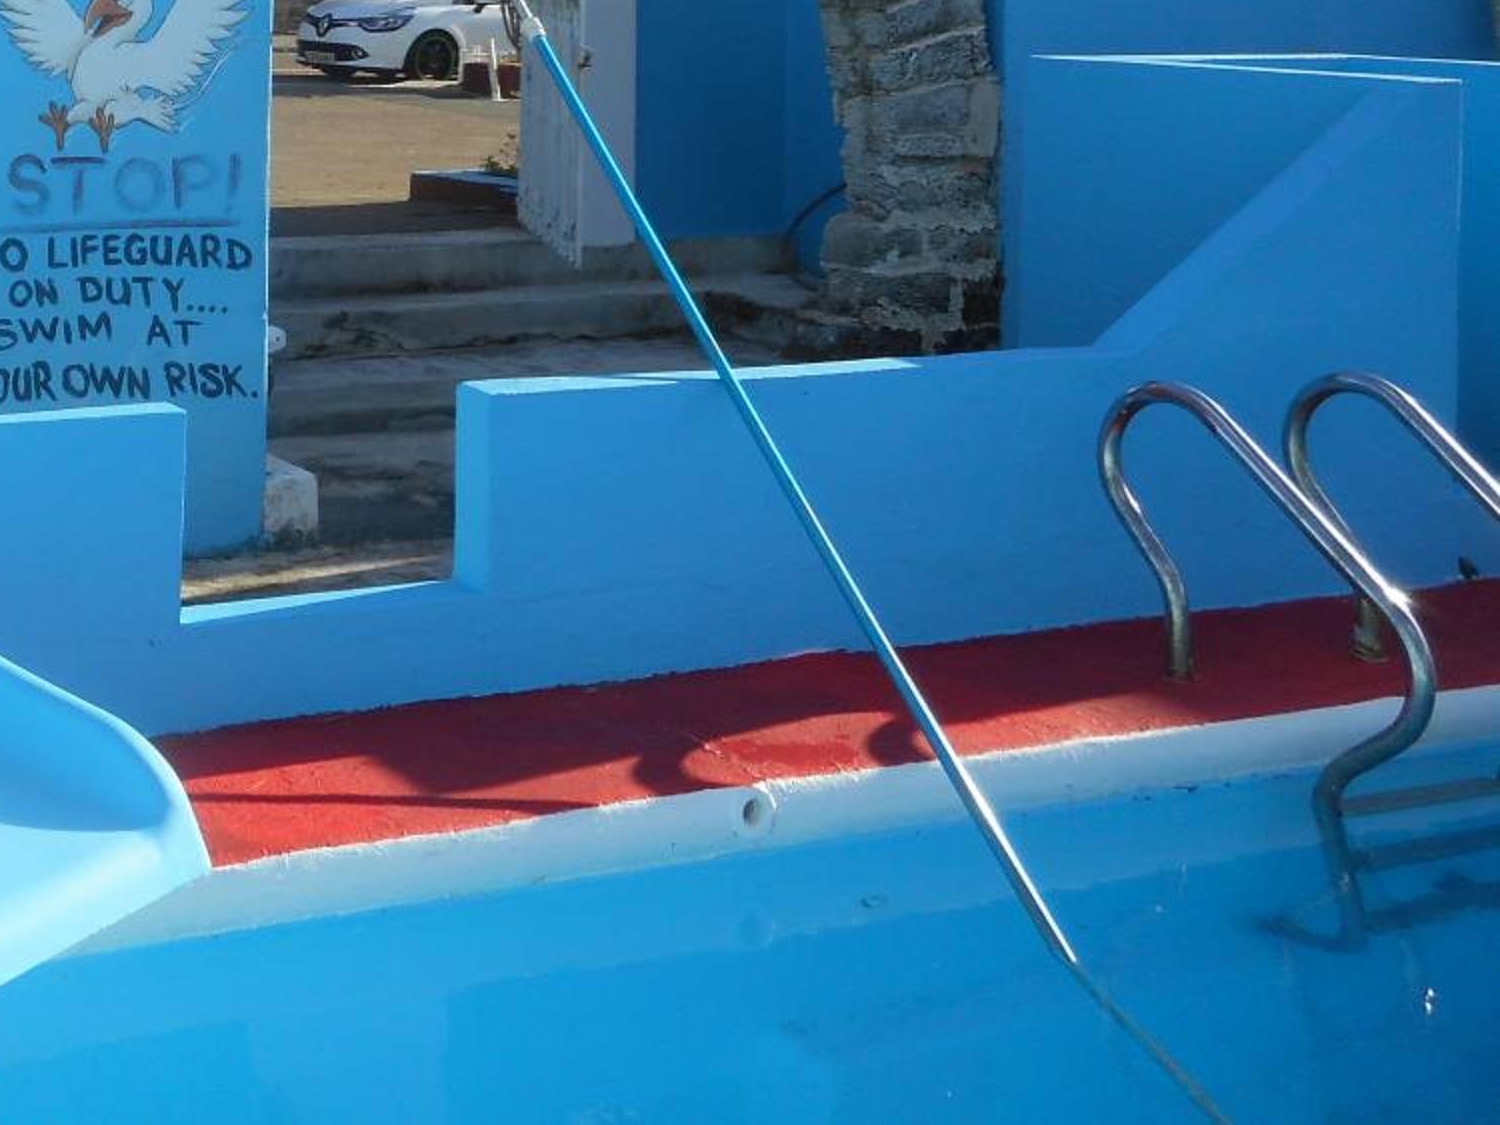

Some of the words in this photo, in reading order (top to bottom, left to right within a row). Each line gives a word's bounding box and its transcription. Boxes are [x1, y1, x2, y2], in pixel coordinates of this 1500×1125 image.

[7, 153, 242, 216] STOP!
[46, 233, 253, 270] LIFEGUARD
[8, 279, 59, 308] ON
[147, 315, 204, 347] AT
[62, 363, 150, 400] OWN
[163, 361, 259, 399] RISK.
